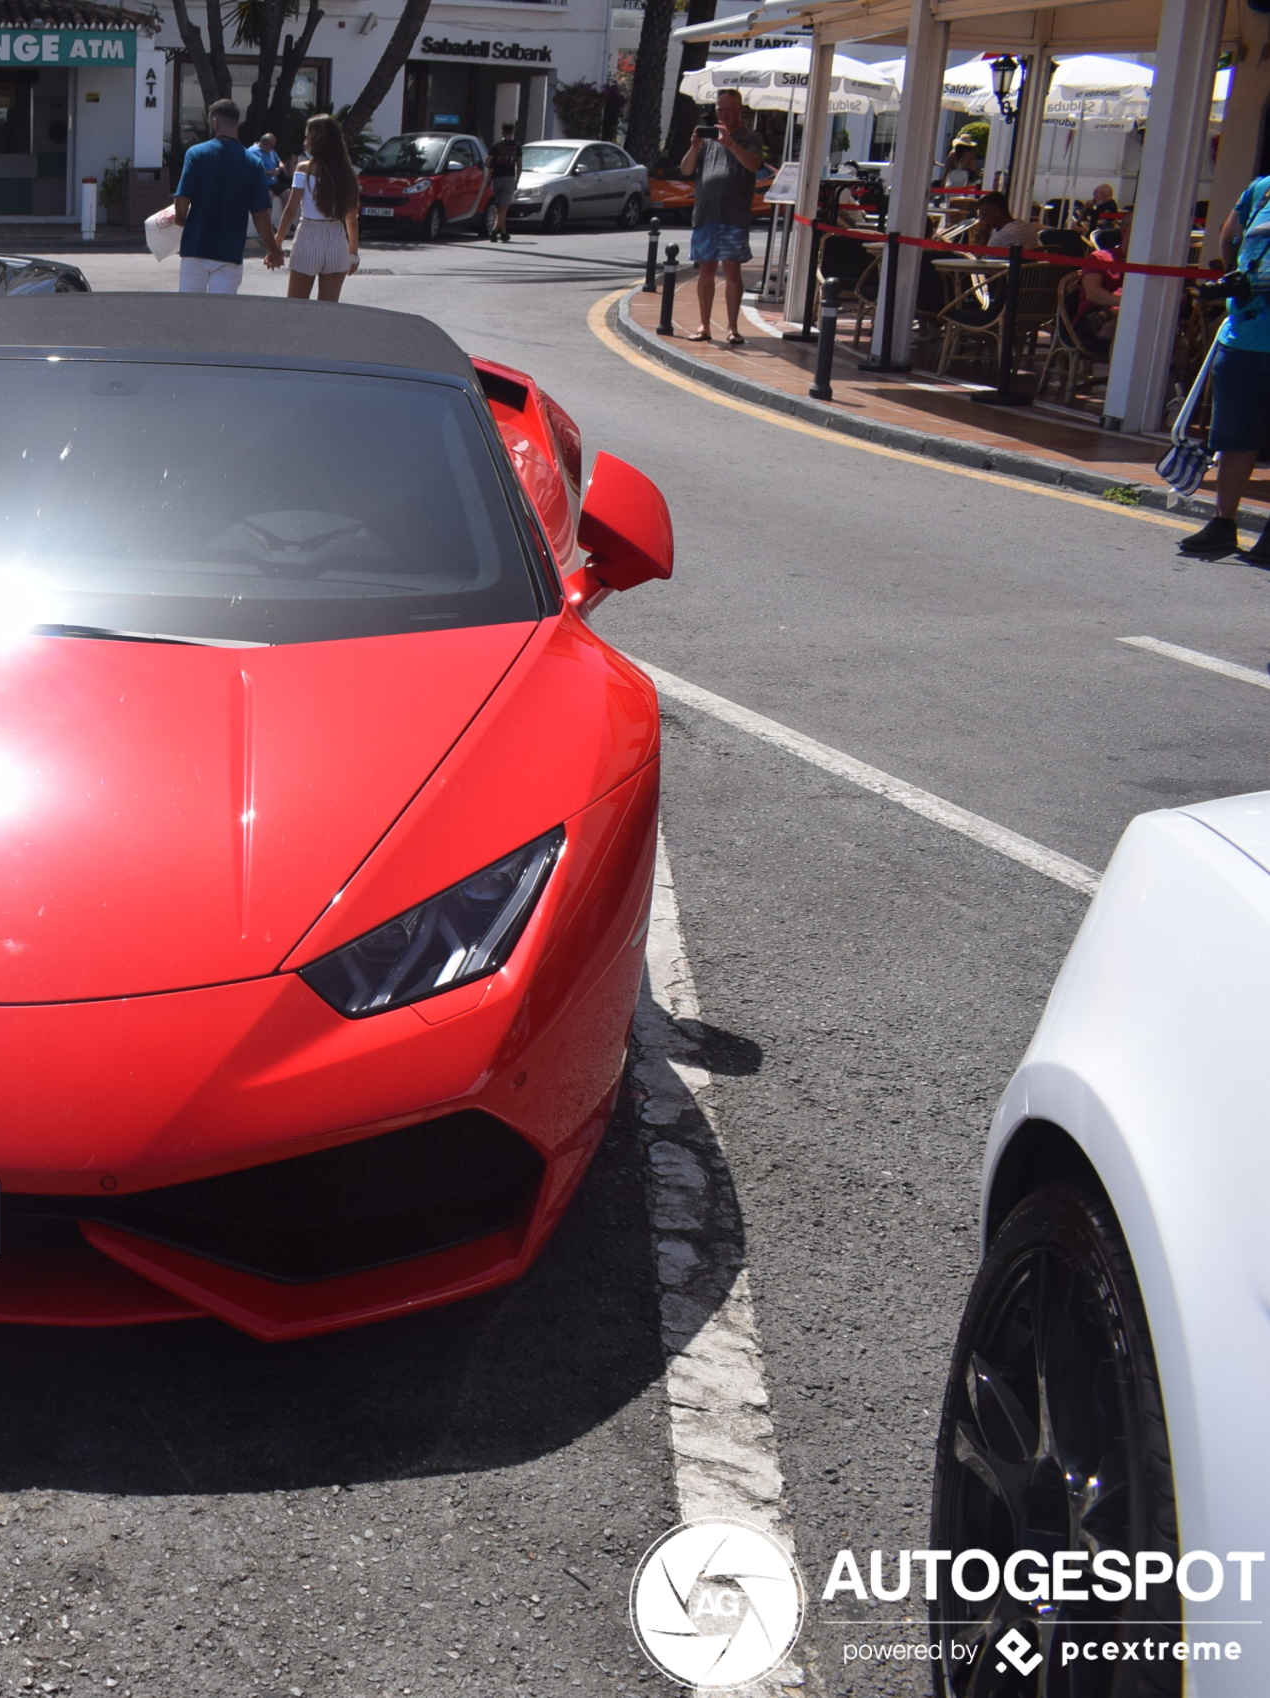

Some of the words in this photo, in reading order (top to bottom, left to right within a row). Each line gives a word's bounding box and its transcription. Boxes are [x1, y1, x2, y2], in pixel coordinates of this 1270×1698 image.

[69, 39, 125, 59] ATM
[421, 36, 490, 58] Sabadell
[492, 42, 552, 62] Solbank
[145, 67, 157, 108] ATM
[782, 73, 809, 86] Sald
